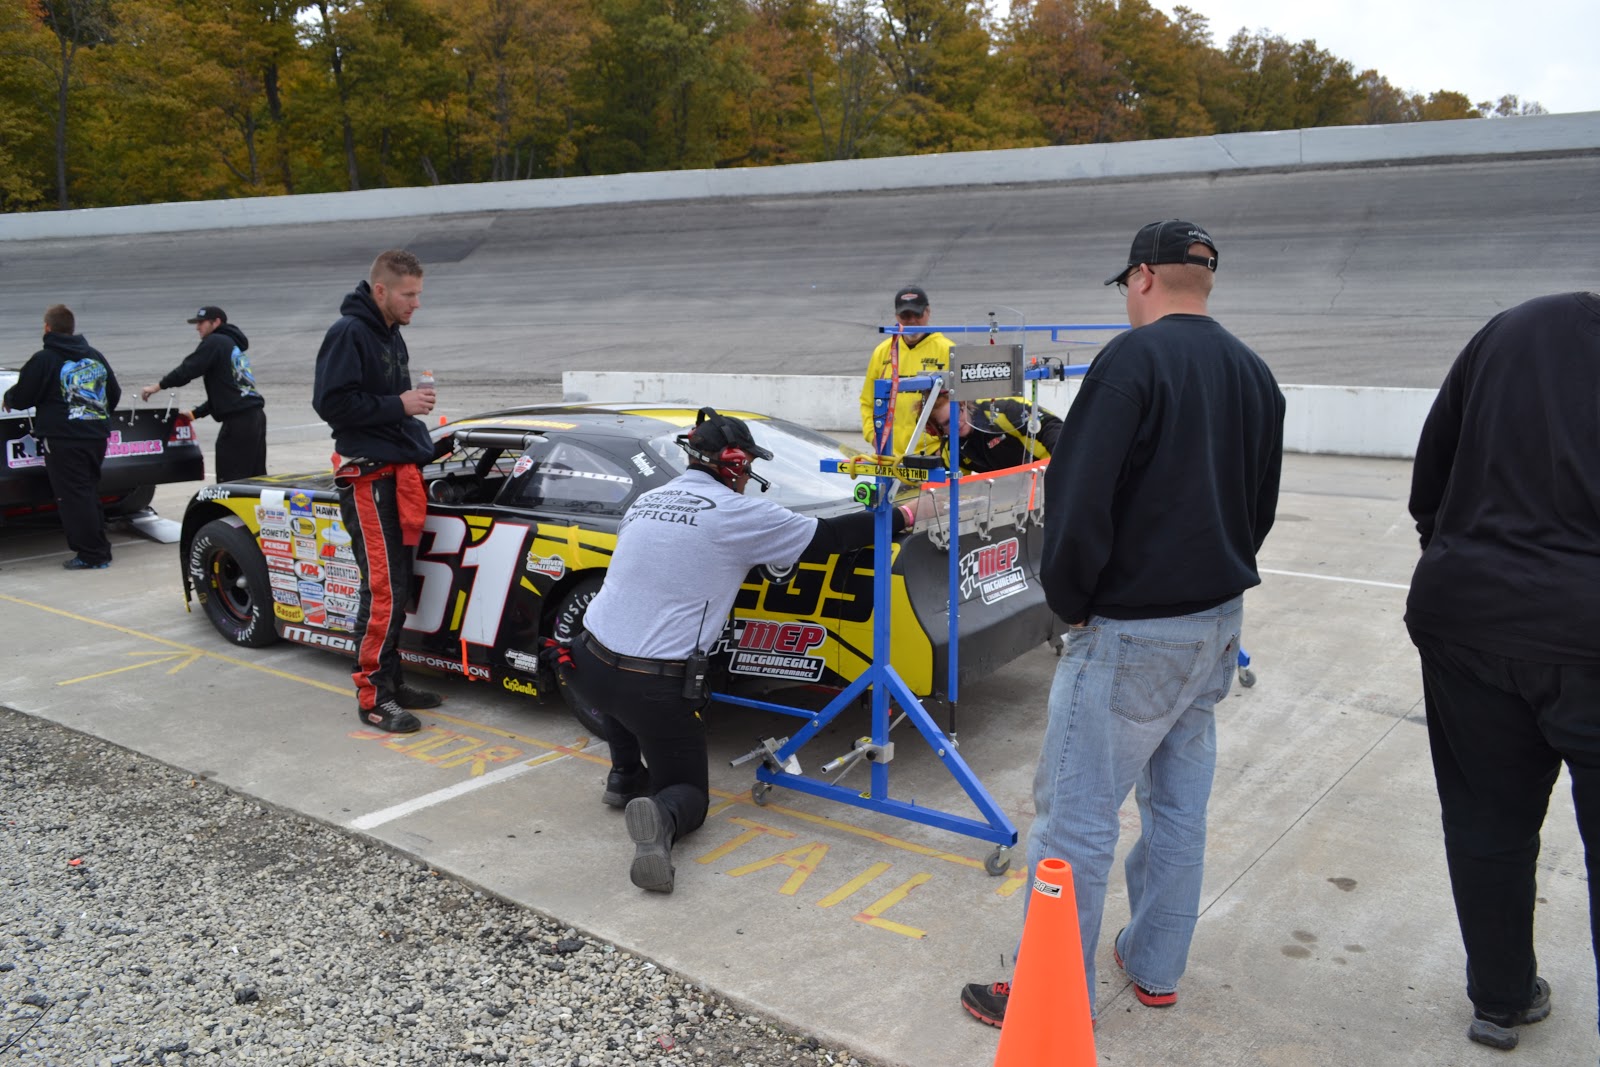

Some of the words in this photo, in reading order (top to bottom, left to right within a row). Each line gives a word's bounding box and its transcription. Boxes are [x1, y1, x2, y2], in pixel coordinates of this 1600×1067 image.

[961, 364, 1011, 380] referee
[888, 466, 910, 478] PSES
[196, 486, 231, 501] Hoosier
[315, 506, 339, 517] HAWK
[263, 540, 291, 551] PENSKE
[190, 536, 213, 582] Hoosier
[978, 541, 1018, 581] MEP
[327, 583, 355, 595] COMP
[276, 605, 301, 619] Bassett
[327, 599, 359, 612] Swif
[738, 621, 824, 654] MEP
[737, 653, 818, 671] MCGUNEGILL
[736, 664, 761, 673] ENGINE
[762, 666, 814, 678] PERFORMANCE
[694, 815, 934, 940] TAIL
